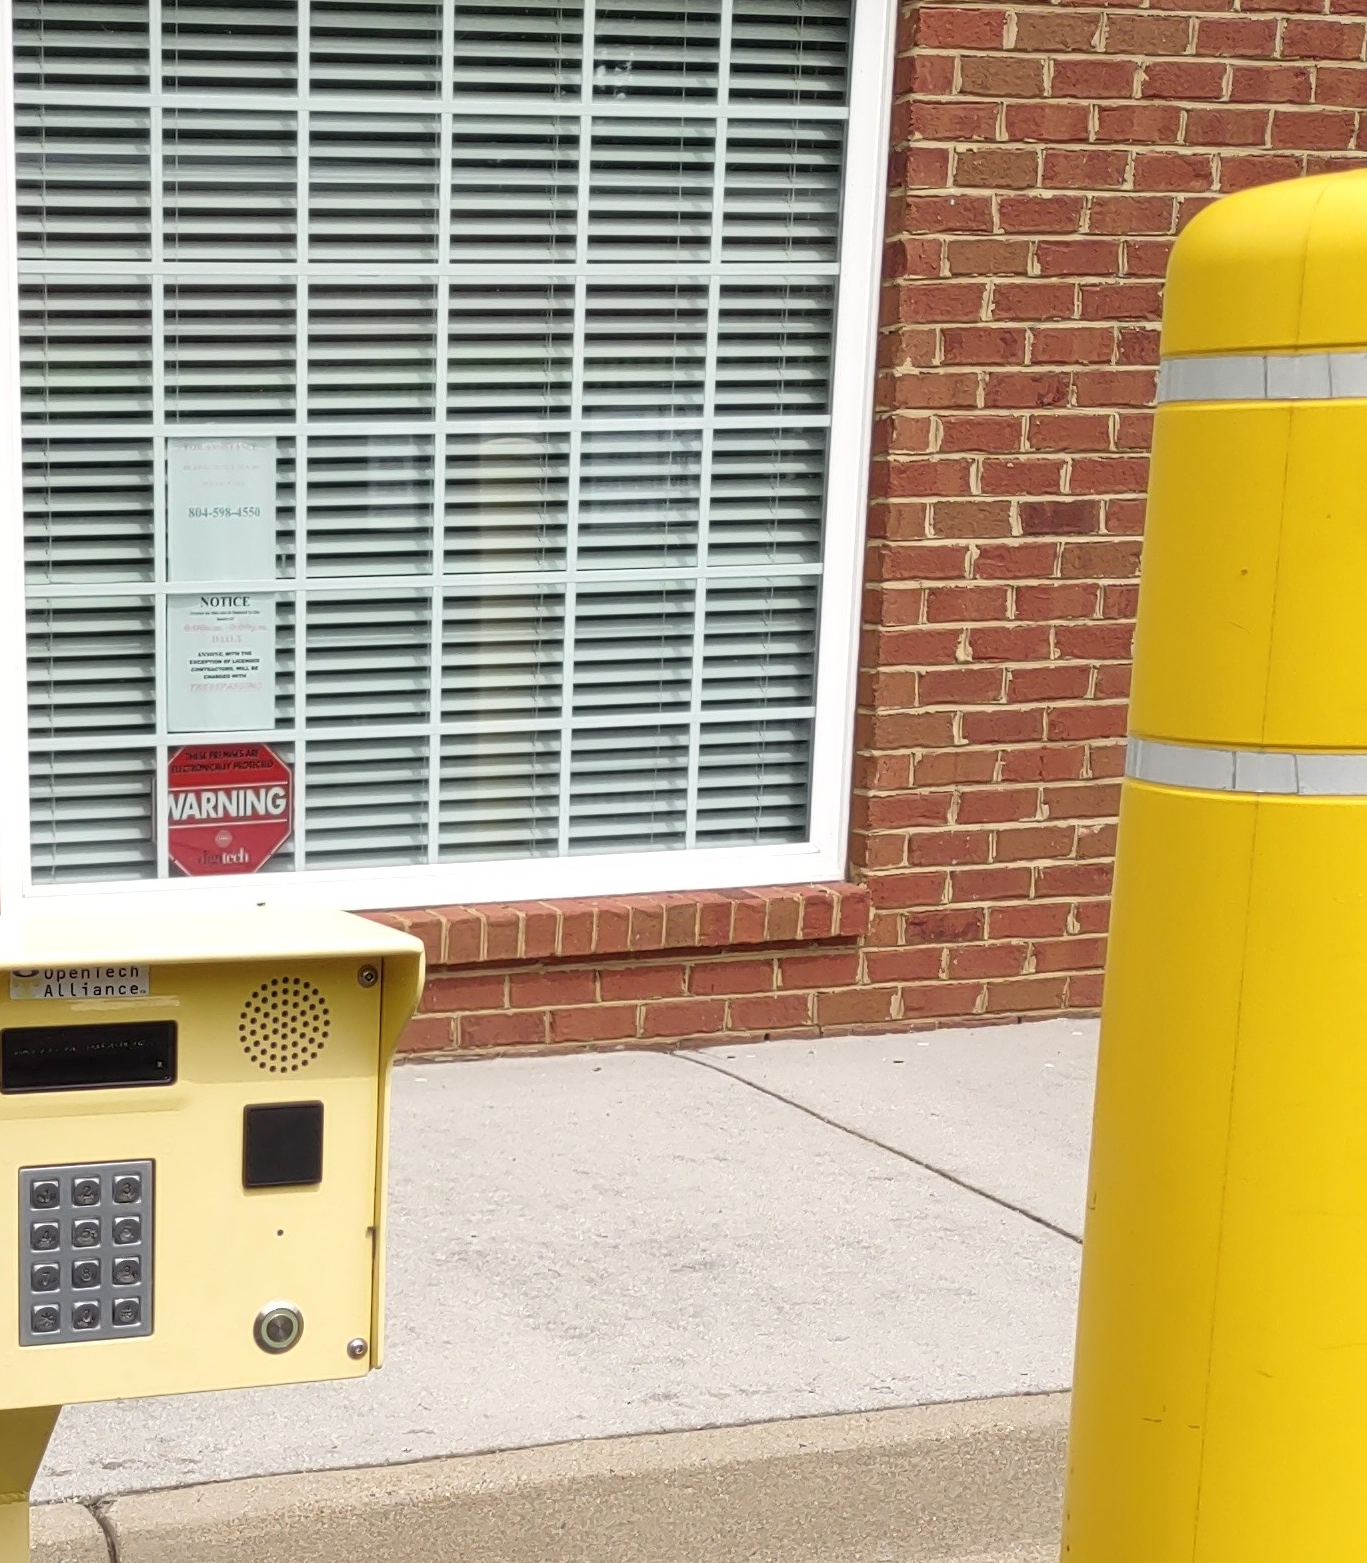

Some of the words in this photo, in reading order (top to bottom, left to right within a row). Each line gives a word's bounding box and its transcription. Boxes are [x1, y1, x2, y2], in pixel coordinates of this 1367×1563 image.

[188, 506, 261, 518] 804-598-4550
[200, 597, 251, 608] NOTICE
[168, 787, 287, 820] WARNING
[44, 966, 139, 982] OpenTech
[44, 982, 139, 998] Alliance
